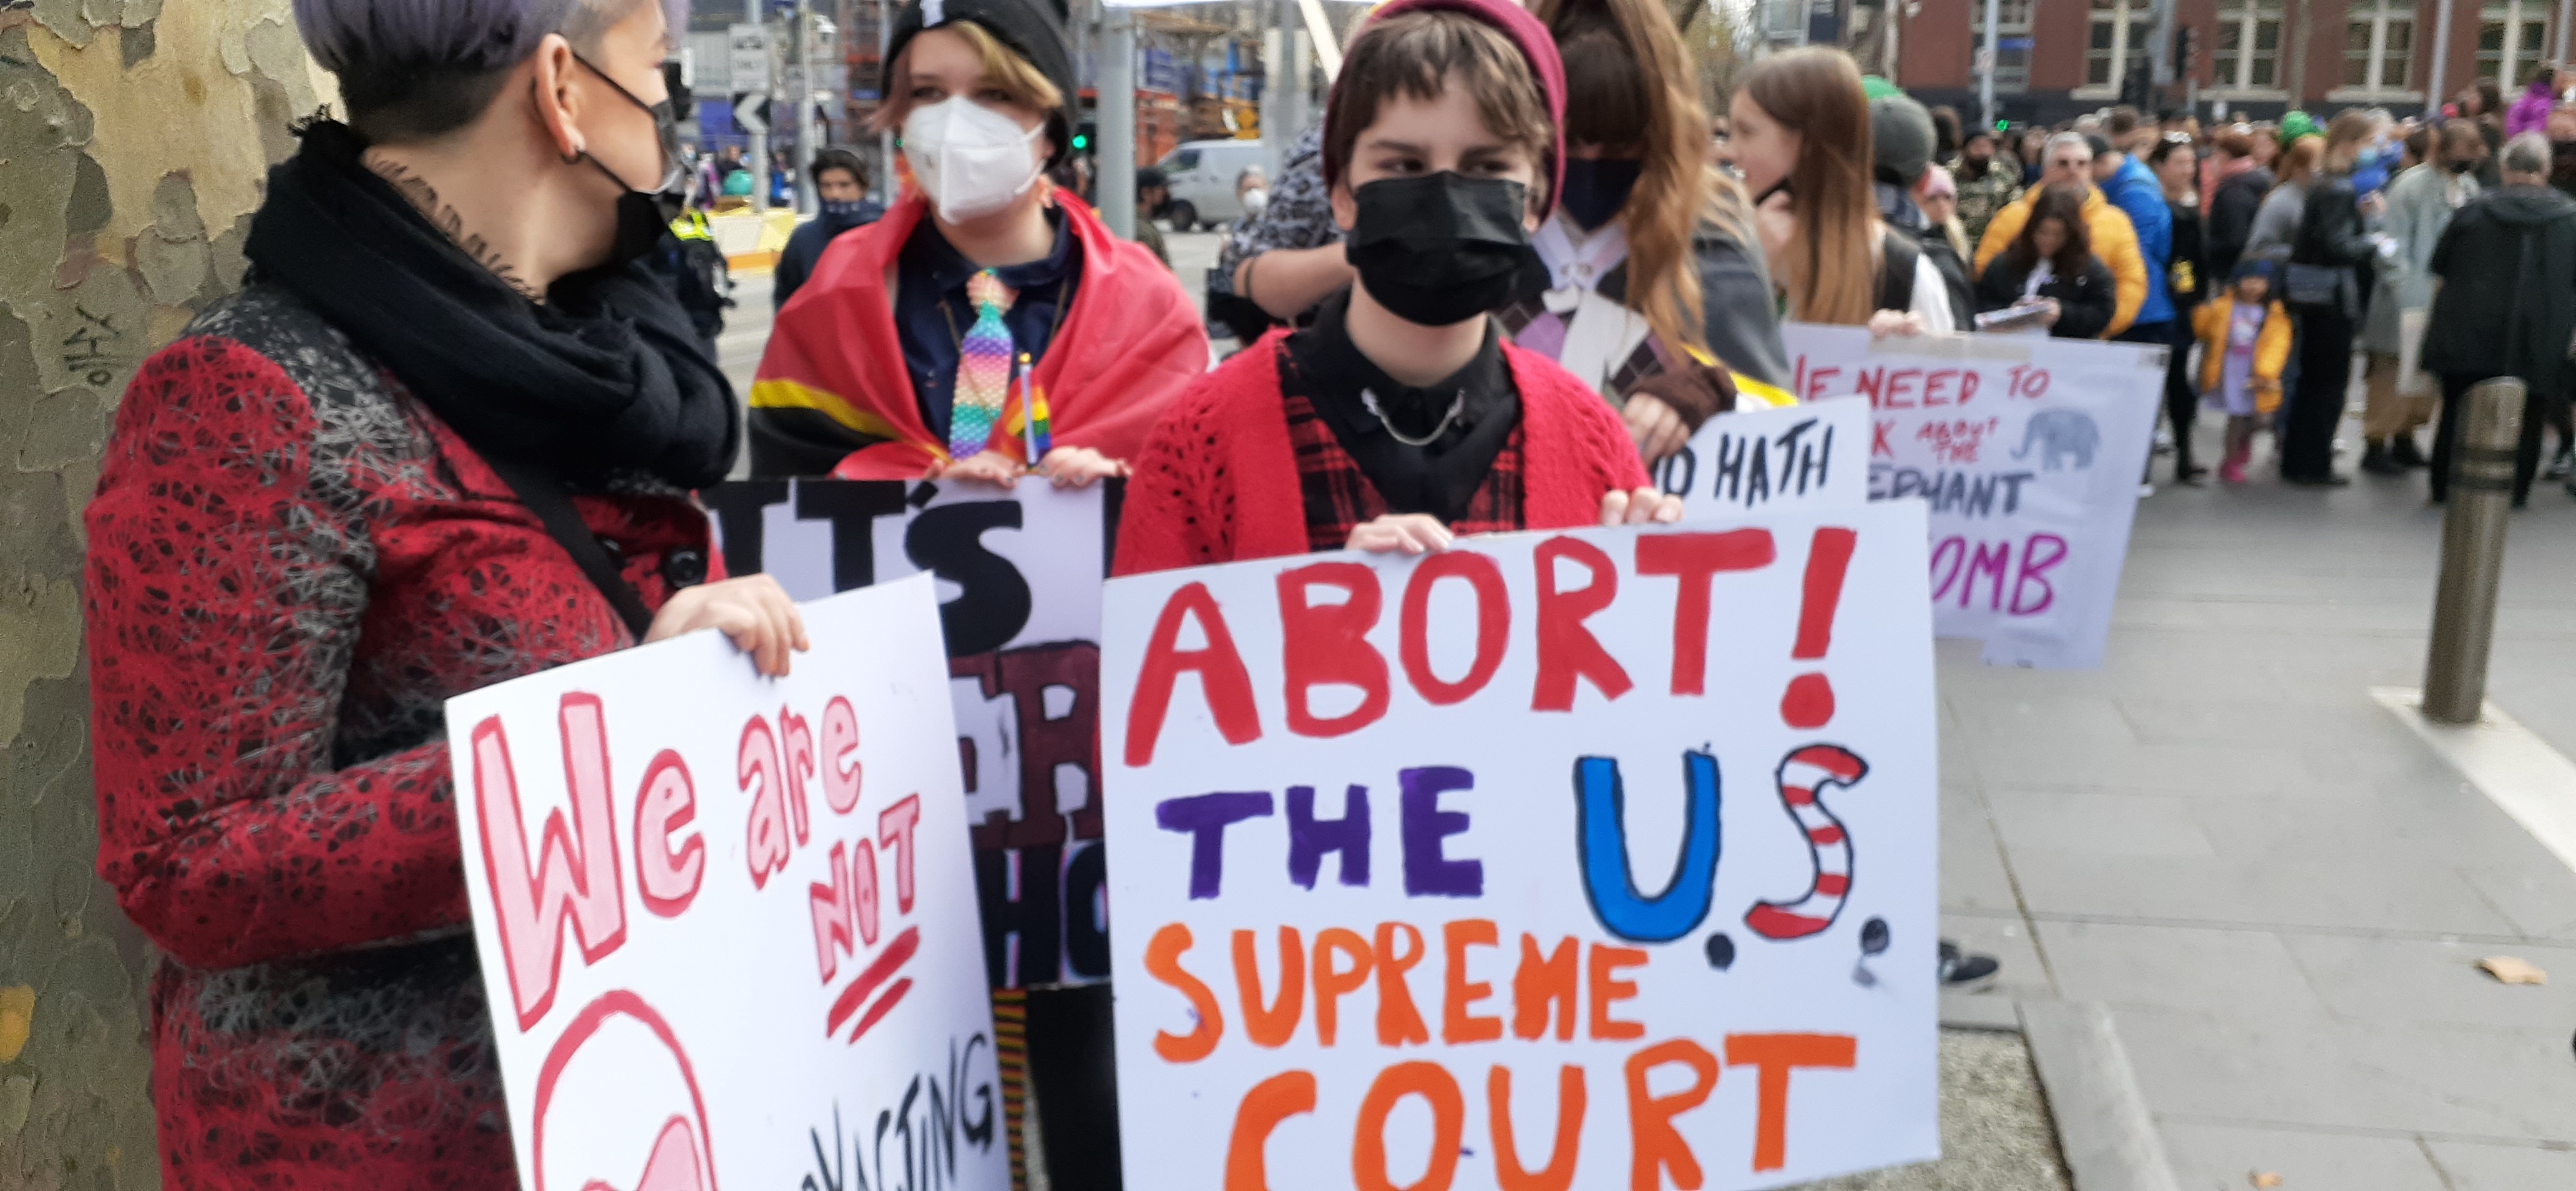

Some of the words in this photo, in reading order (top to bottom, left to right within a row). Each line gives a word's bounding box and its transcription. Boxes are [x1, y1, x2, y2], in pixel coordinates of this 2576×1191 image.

[1713, 416, 1834, 509] HATH
[1855, 365, 1980, 410] NEED
[2008, 364, 2051, 399] TO
[1915, 416, 1999, 445] ABOUT
[700, 479, 1032, 657] IT'S
[1123, 527, 1858, 768] ABORT!
[470, 689, 707, 1034] We
[737, 694, 862, 891] are
[807, 792, 921, 986] NOT
[1155, 765, 1485, 900] THE
[1573, 740, 1891, 971] U.S.
[1144, 918, 1649, 1064] SUPREME
[1223, 1033, 1857, 1191] COURT
